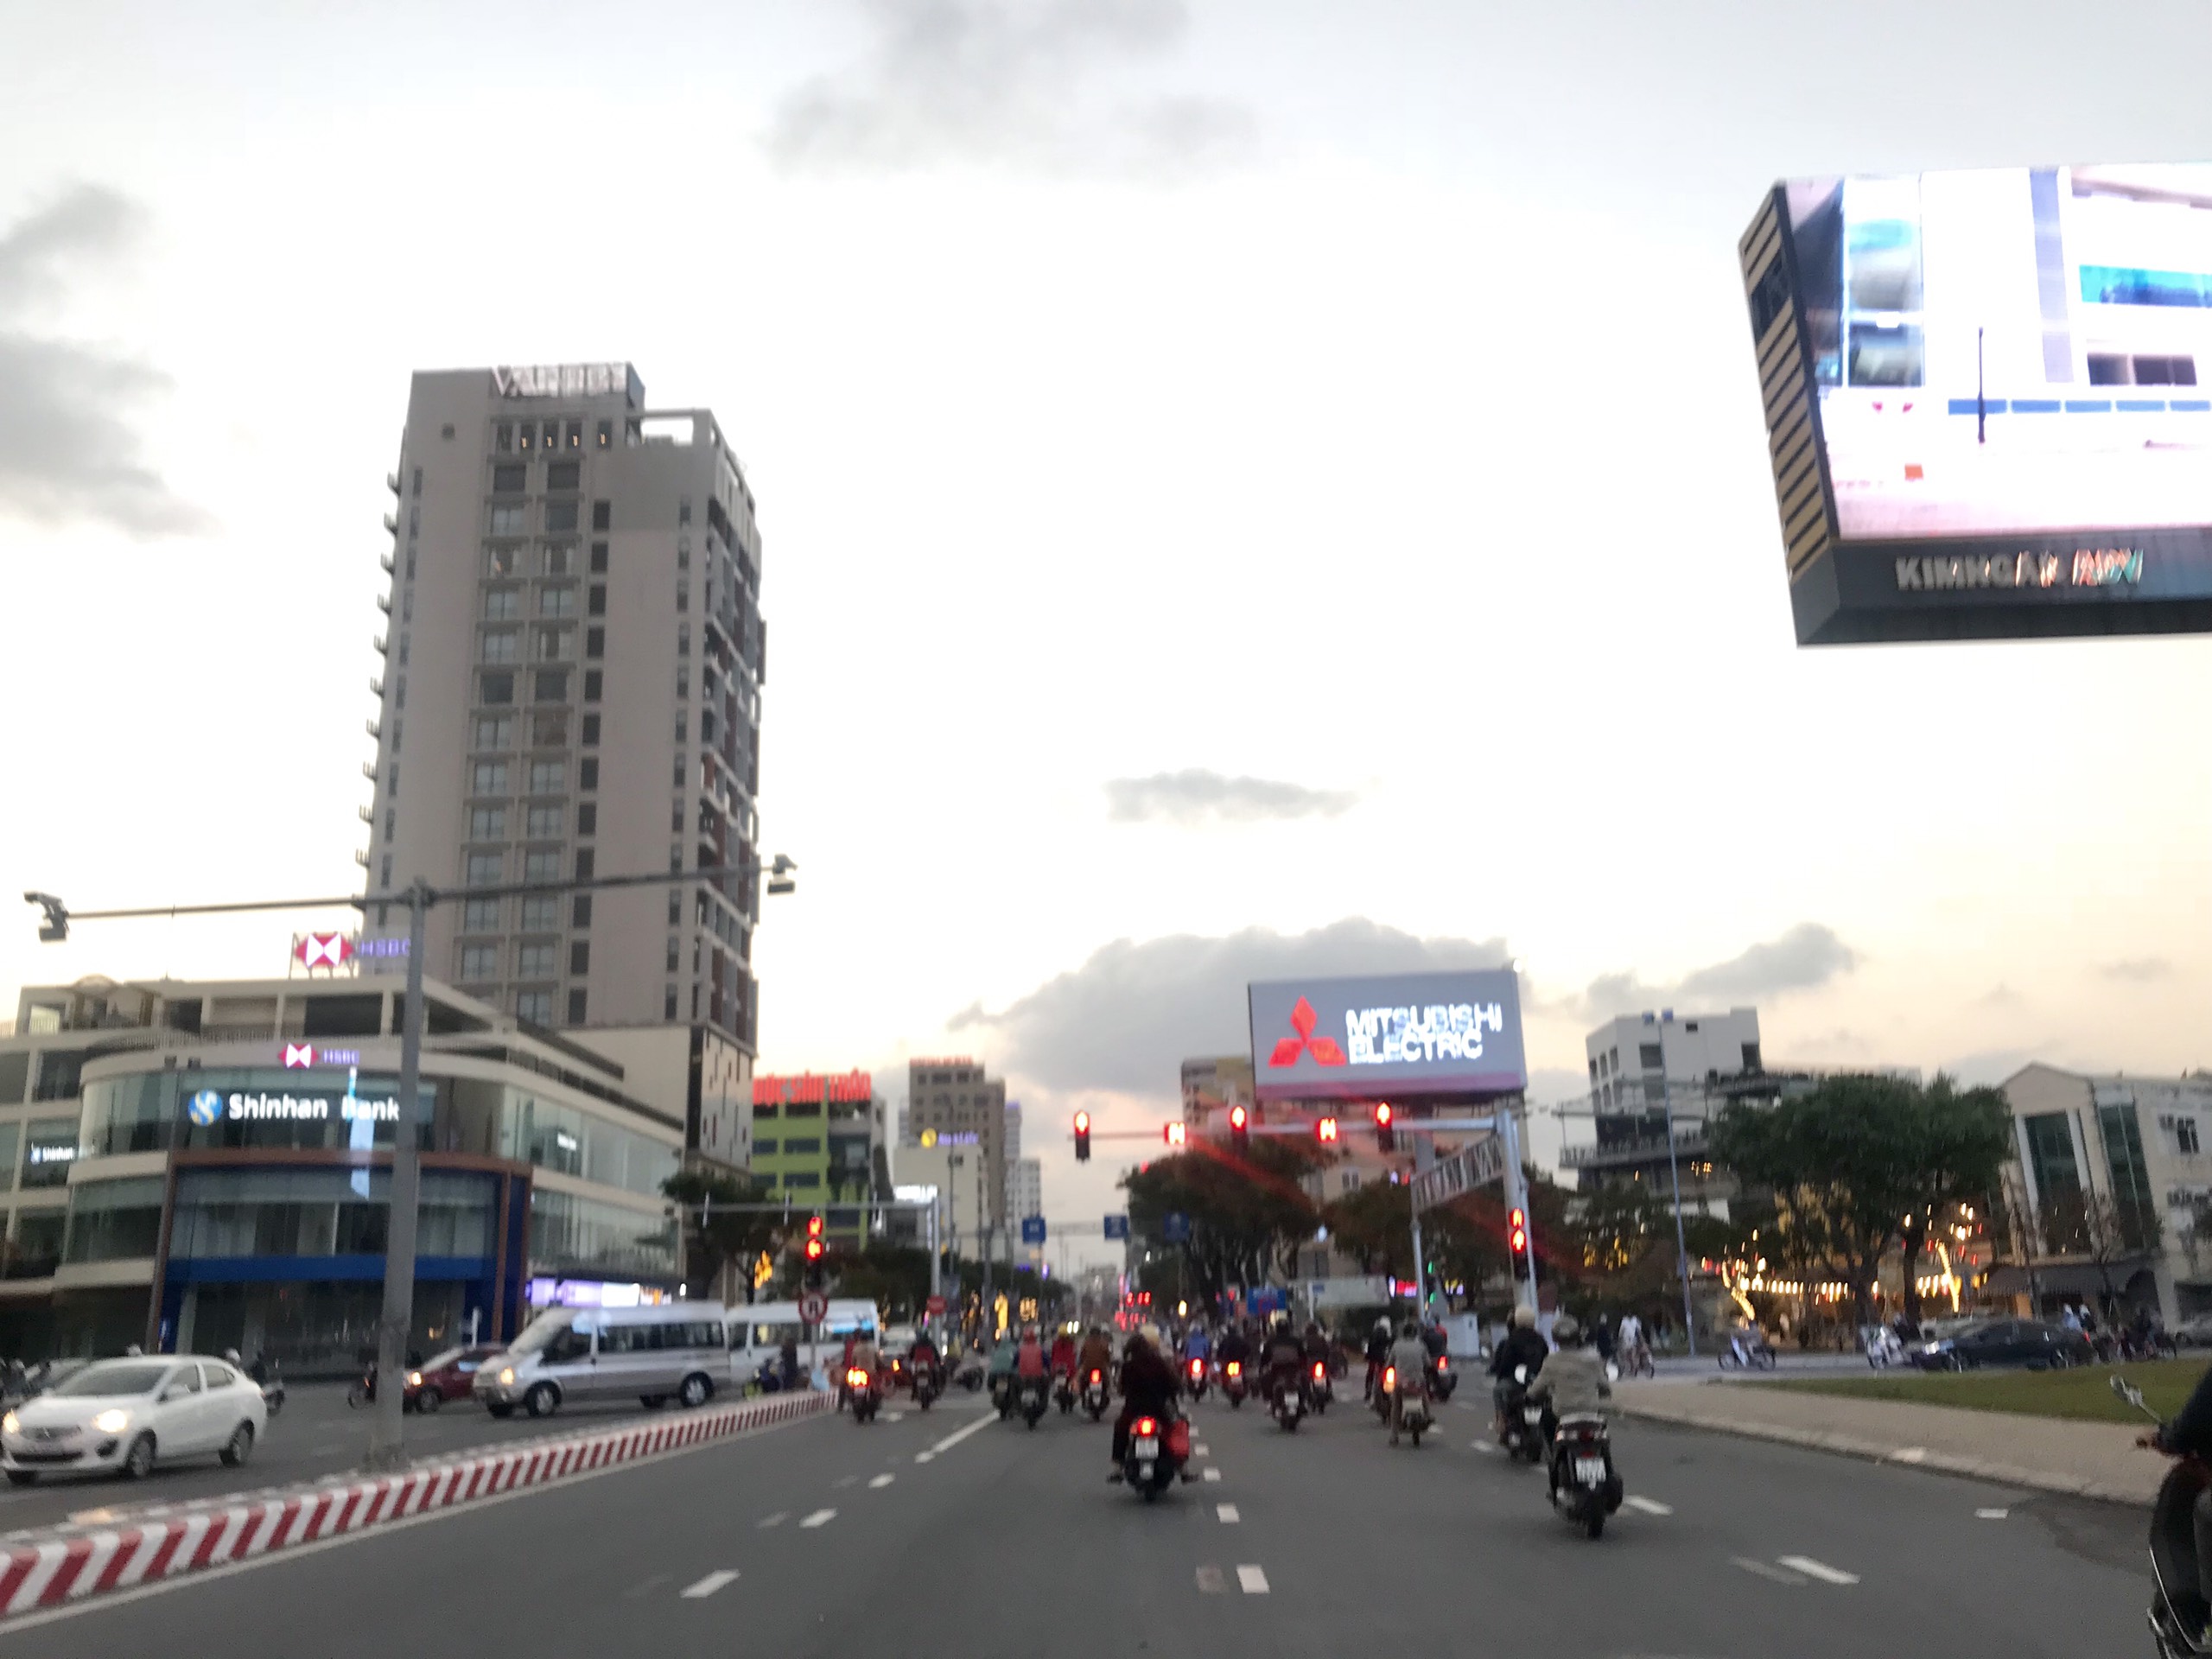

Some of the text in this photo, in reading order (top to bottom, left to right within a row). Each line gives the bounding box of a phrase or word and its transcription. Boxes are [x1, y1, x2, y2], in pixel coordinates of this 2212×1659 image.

[1345, 1000, 1503, 1039] MITSUBISHI
[1347, 1027, 1484, 1065] ELECTRIC
[228, 1092, 400, 1122] Shinhan Bank
